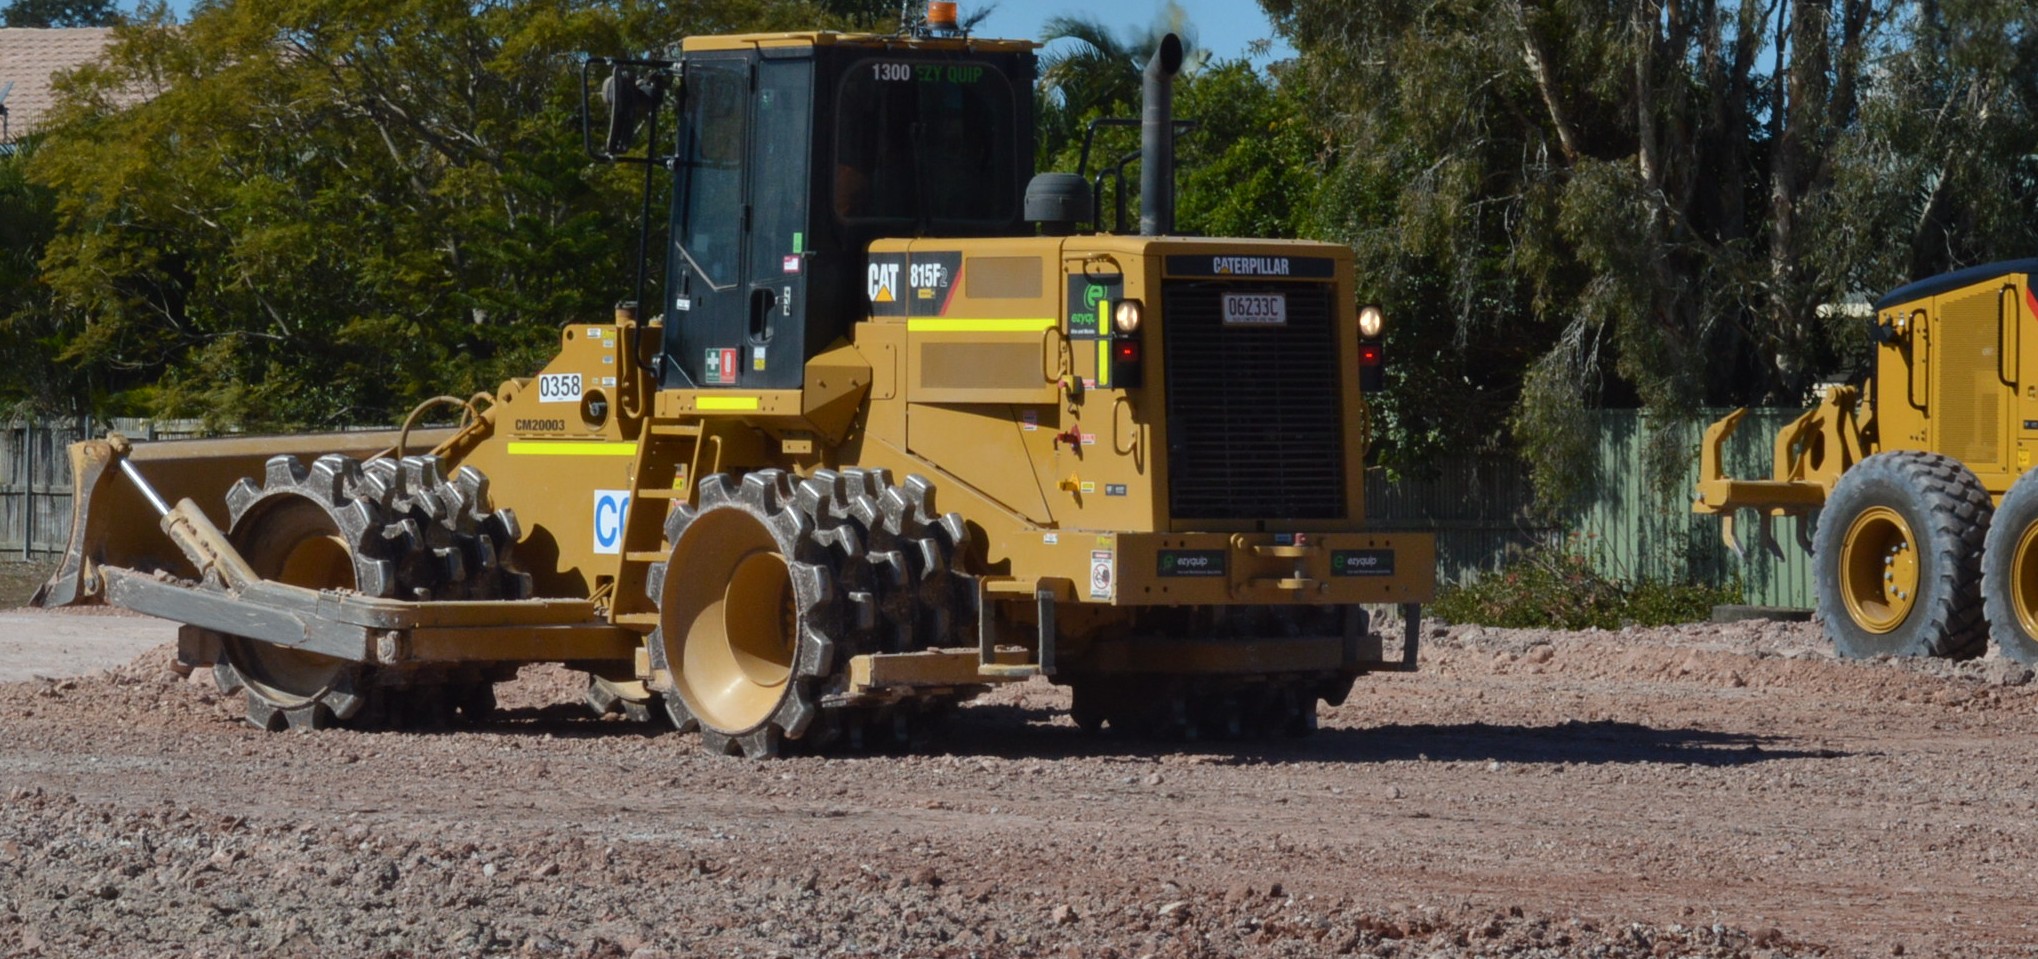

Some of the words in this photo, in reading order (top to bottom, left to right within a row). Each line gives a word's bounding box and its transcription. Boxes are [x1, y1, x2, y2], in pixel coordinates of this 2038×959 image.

[872, 63, 911, 81] 1300
[948, 66, 983, 84] QUIP
[1213, 256, 1290, 275] CATERPILLAR
[867, 263, 899, 302] CAT
[1229, 297, 1279, 316] 06233C
[540, 375, 580, 397] 0358
[515, 419, 566, 431] CM20003
